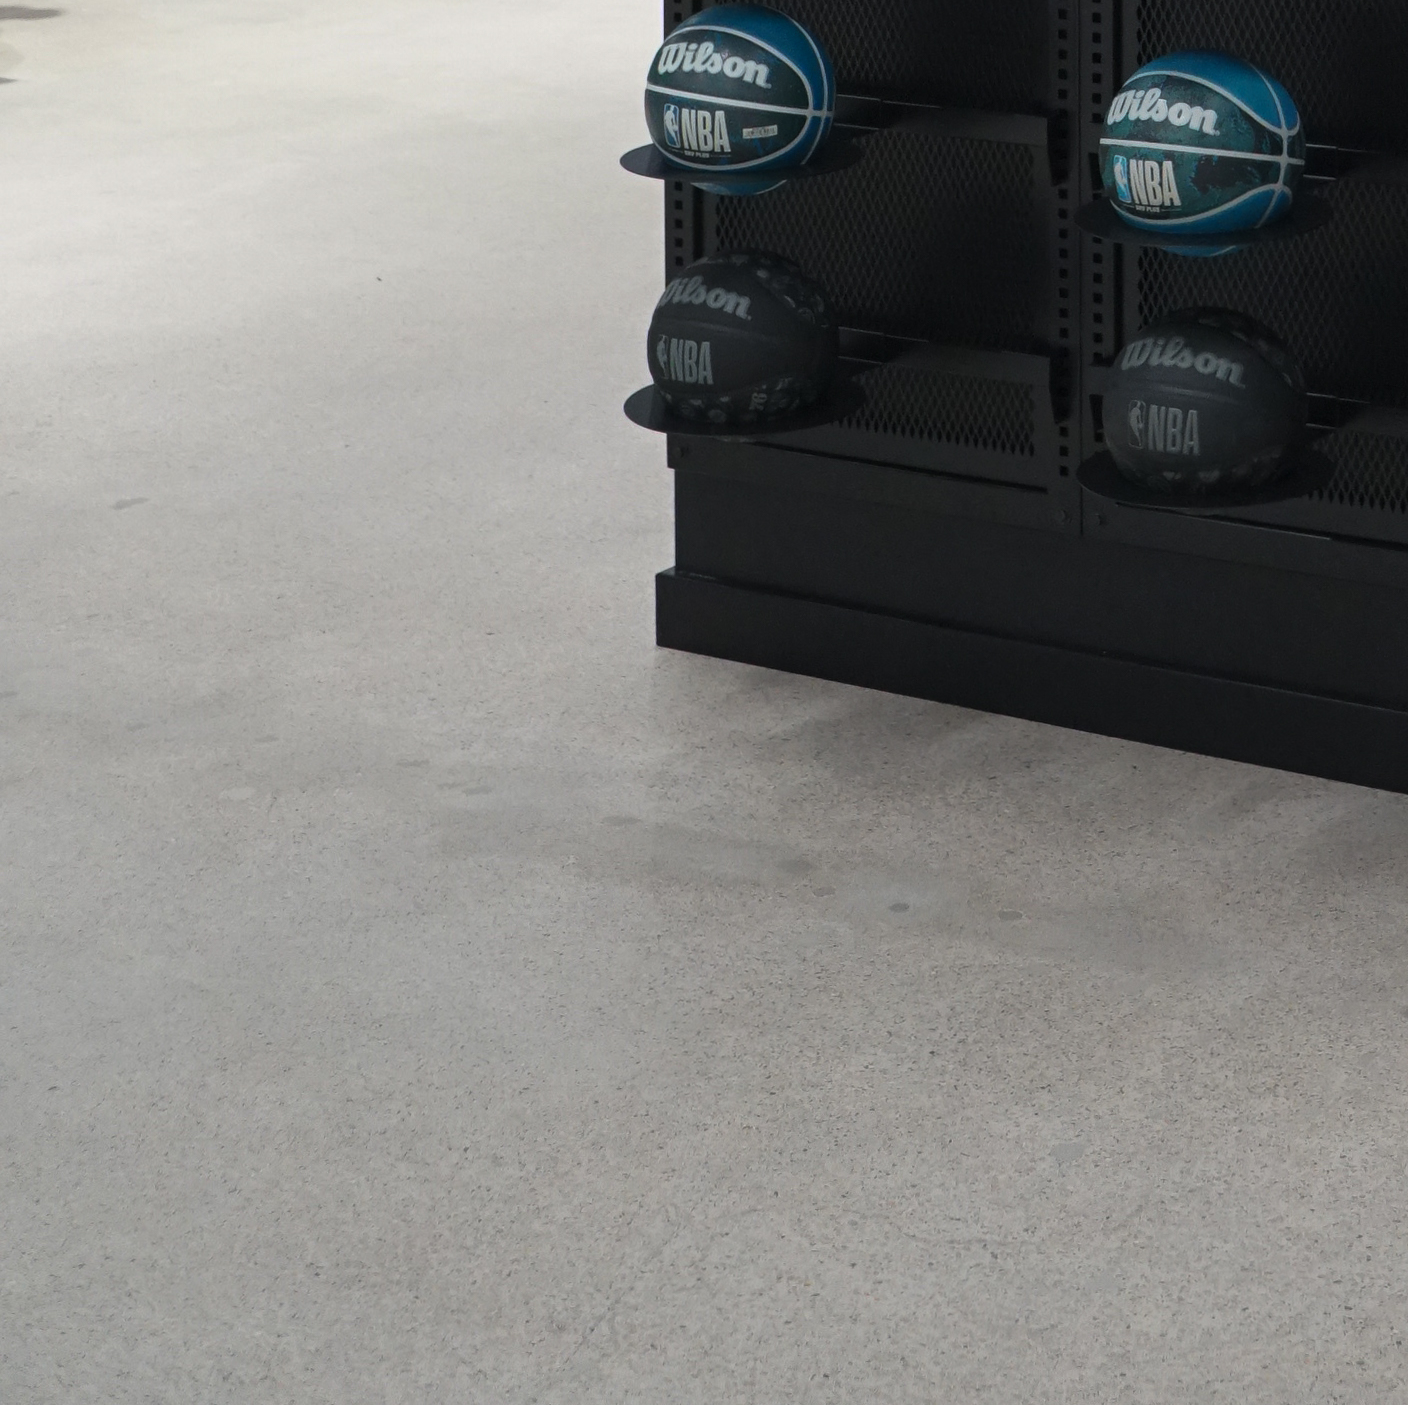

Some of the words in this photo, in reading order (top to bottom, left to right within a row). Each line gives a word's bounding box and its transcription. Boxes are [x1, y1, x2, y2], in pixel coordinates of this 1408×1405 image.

[657, 41, 769, 89] Wilson
[681, 107, 732, 153] NBA
[1106, 88, 1218, 135] Wilson
[1129, 159, 1182, 206] NBA
[670, 338, 714, 385] NBA
[1121, 336, 1245, 388] Wilson
[1150, 405, 1200, 456] NBA
